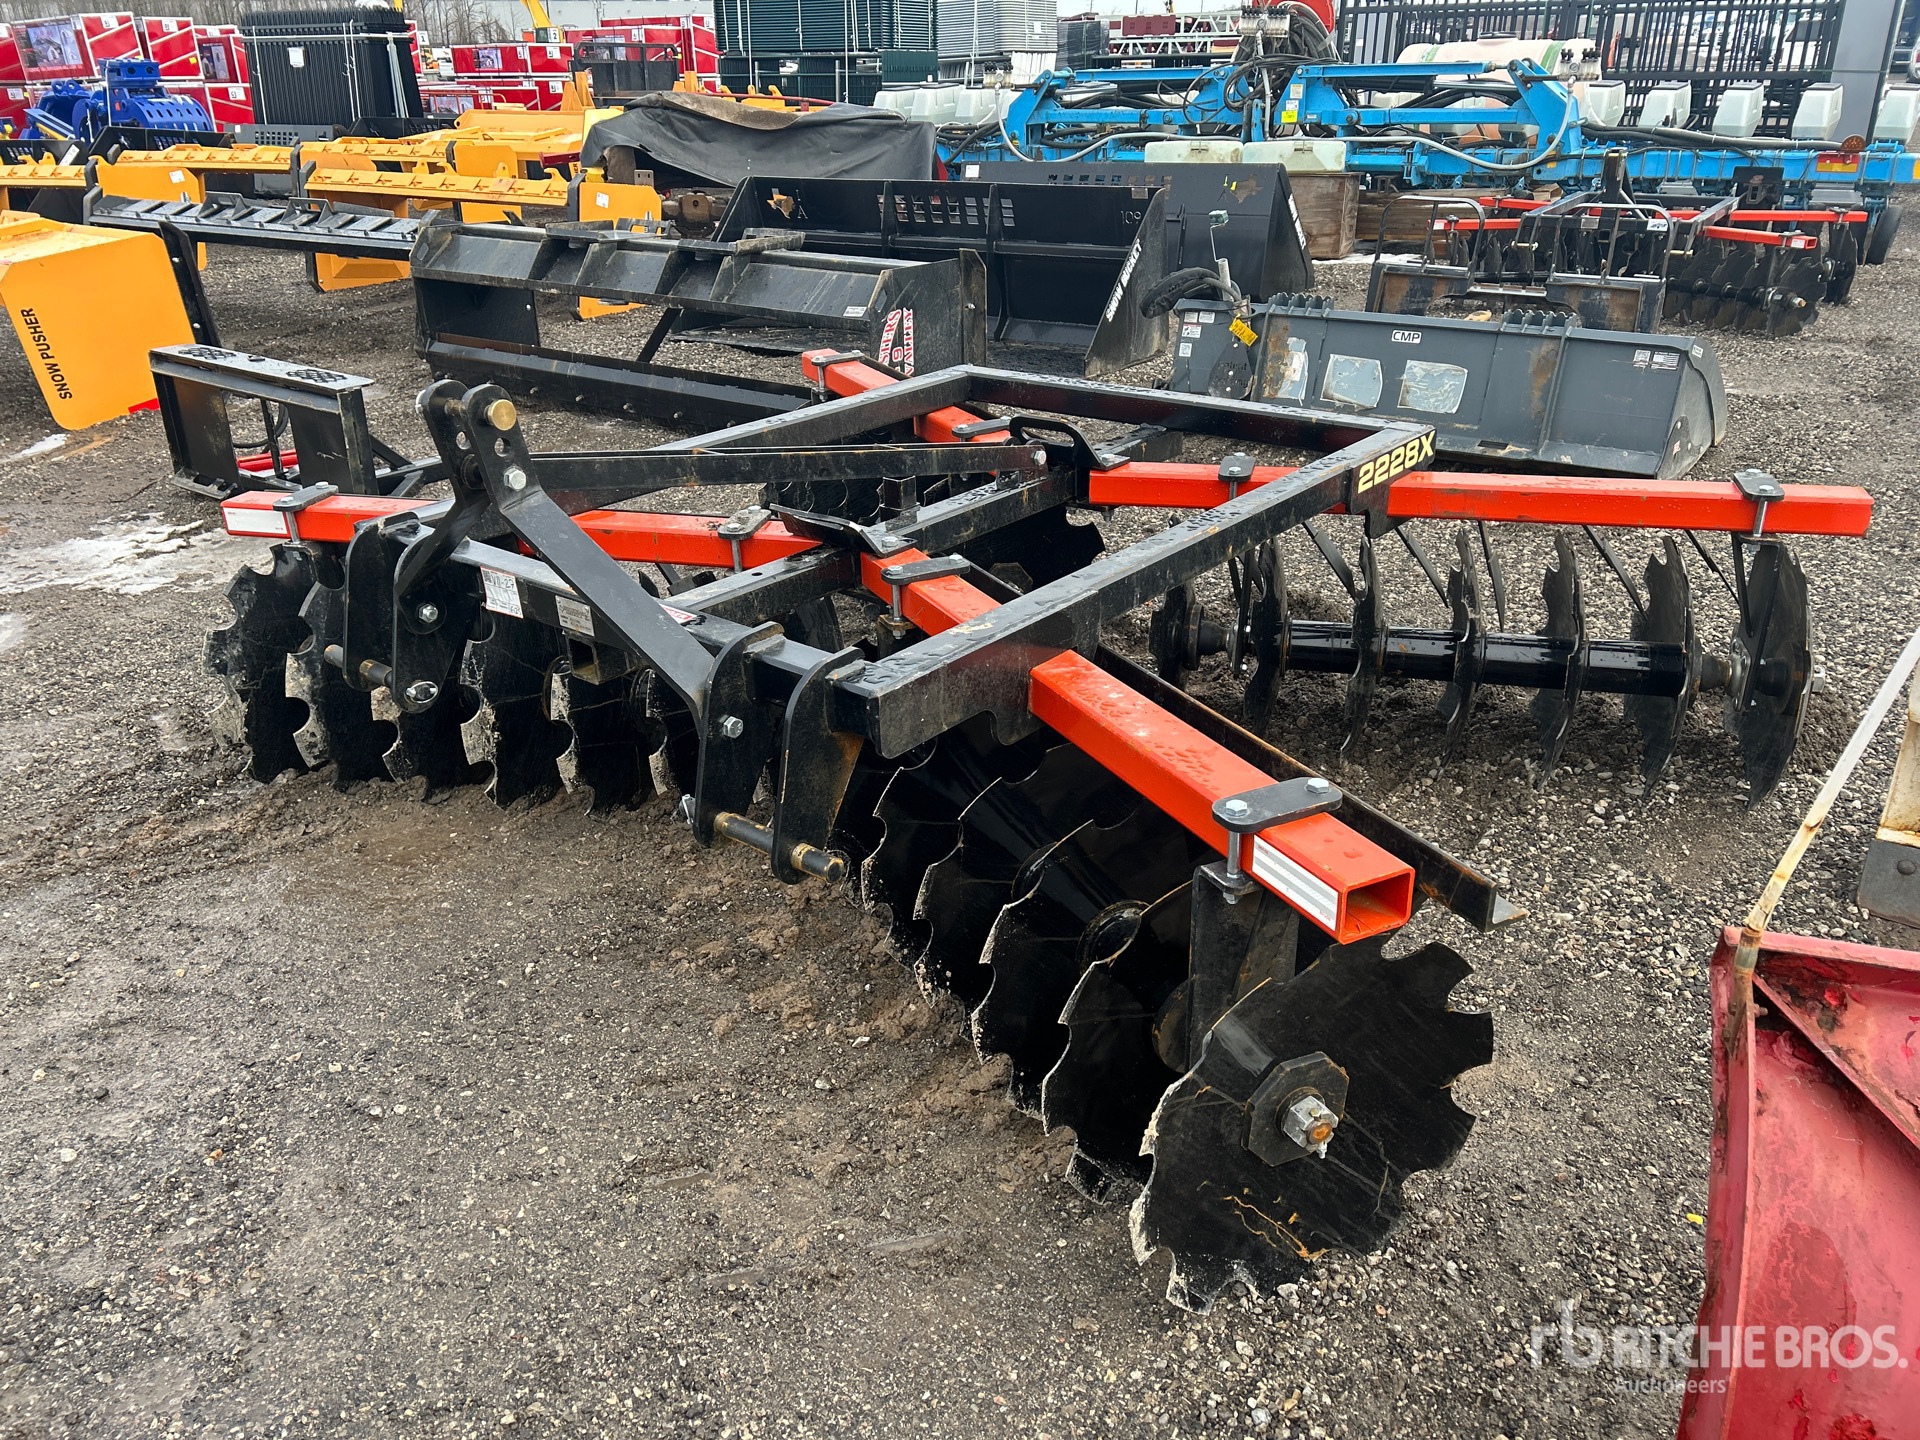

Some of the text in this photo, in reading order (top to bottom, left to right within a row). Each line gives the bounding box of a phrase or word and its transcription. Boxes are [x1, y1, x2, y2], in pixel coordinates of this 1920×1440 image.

[1105, 238, 1142, 322] SNOW BUCKET
[20, 308, 73, 400] SNOW PUSHER
[1393, 331, 1421, 342] CMP
[1357, 430, 1436, 494] 2228X
